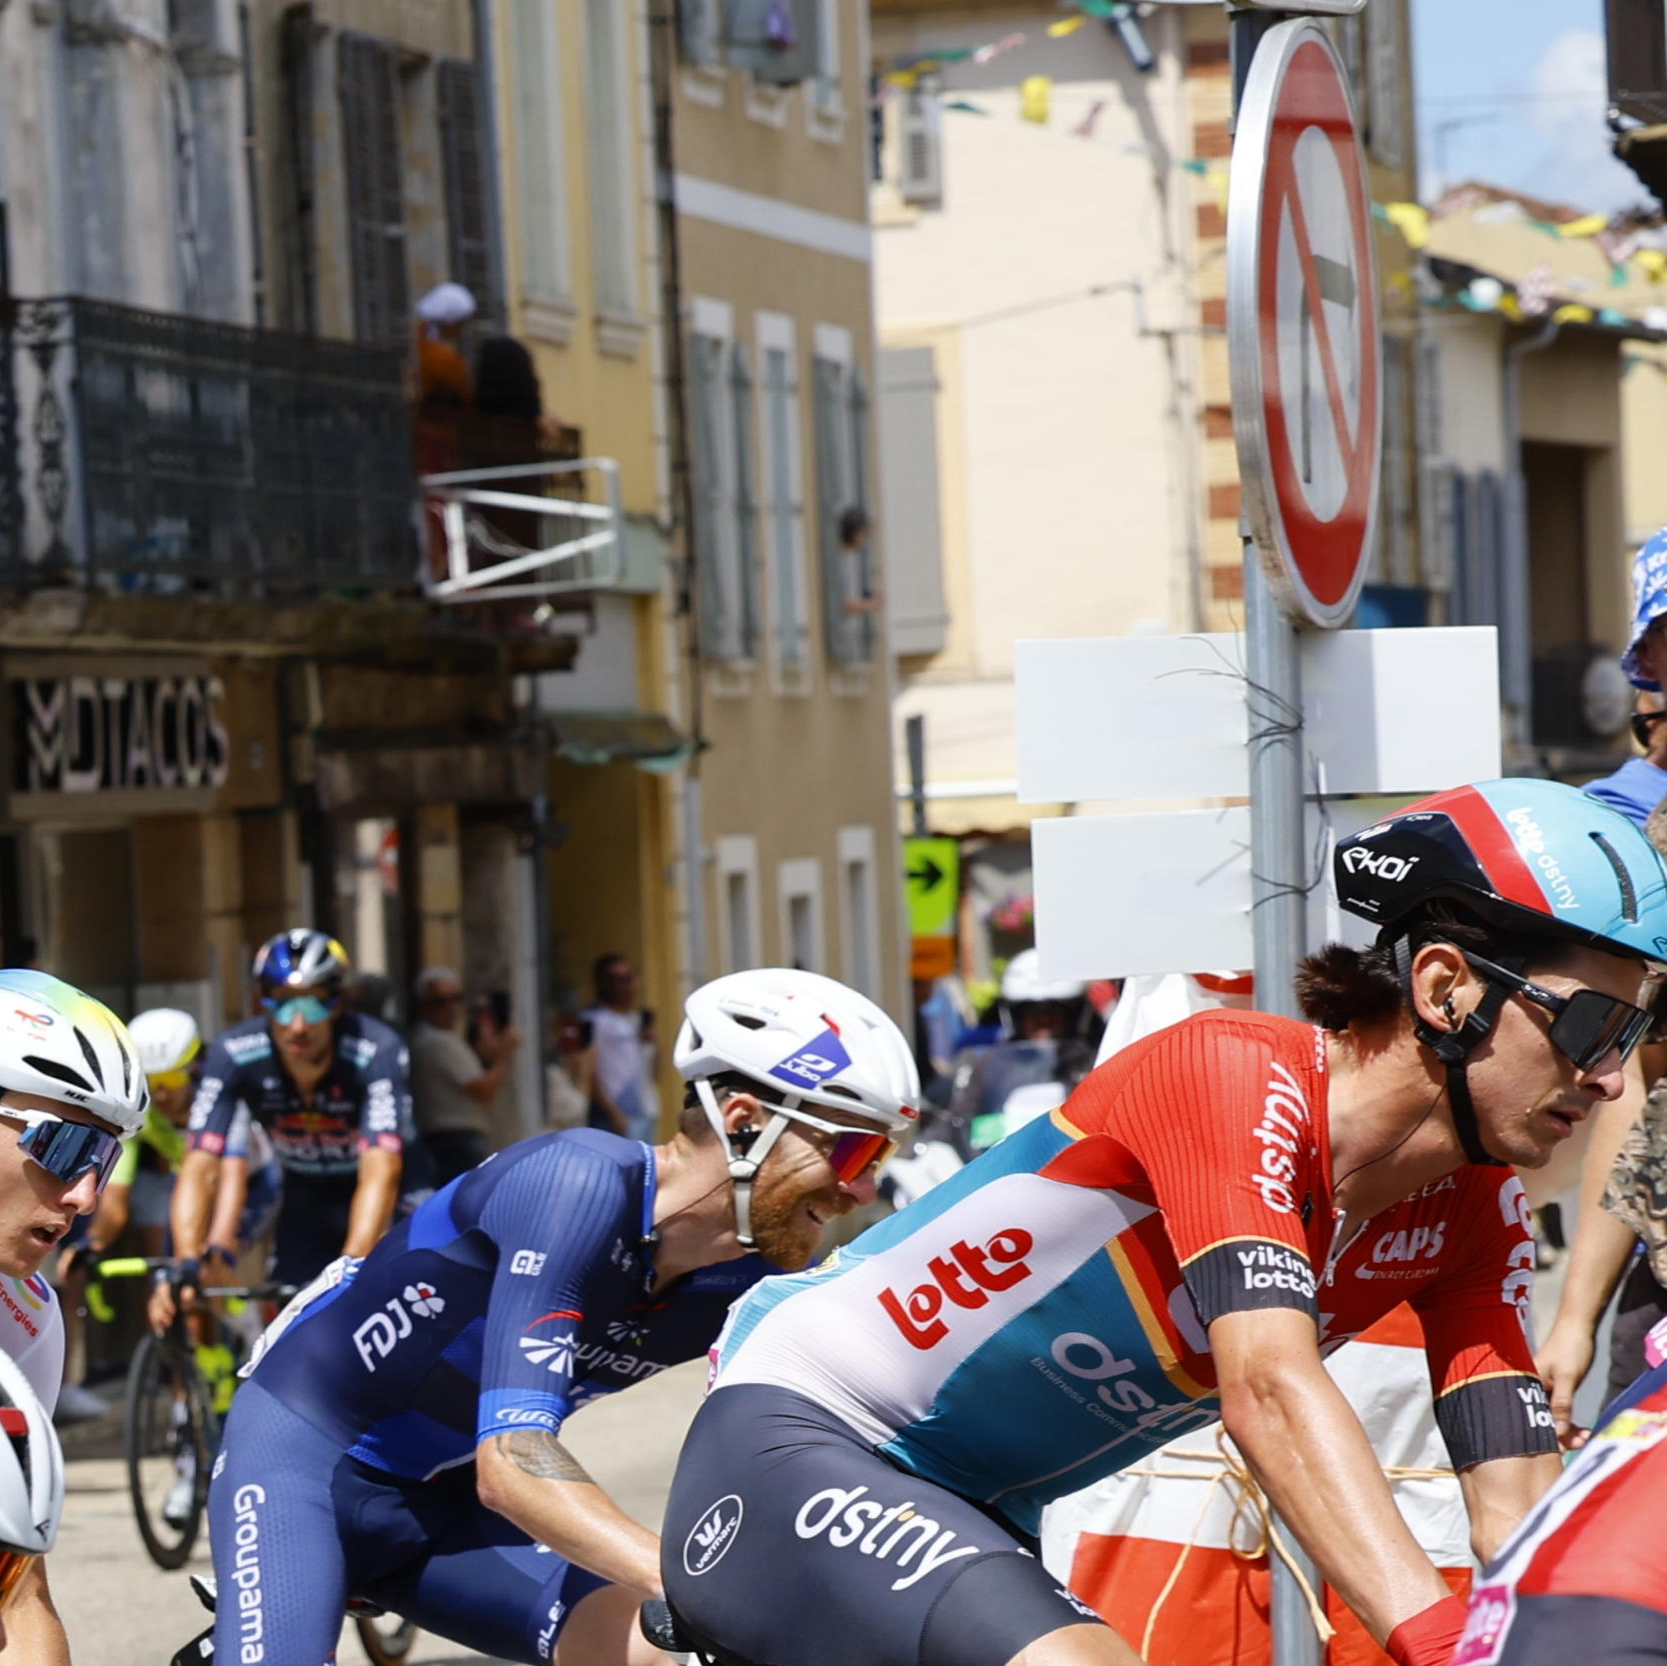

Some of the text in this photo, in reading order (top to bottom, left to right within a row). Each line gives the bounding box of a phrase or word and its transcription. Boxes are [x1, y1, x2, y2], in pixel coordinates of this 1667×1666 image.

[1372, 1221, 1447, 1264] CAPS
[876, 1227, 1034, 1351] lotto
[1243, 1266, 1315, 1299] lotto
[352, 1297, 413, 1373] FDJ
[230, 1483, 266, 1666] Groupama
[694, 1516, 739, 1572] vermarc
[794, 1485, 981, 1592] dstny
